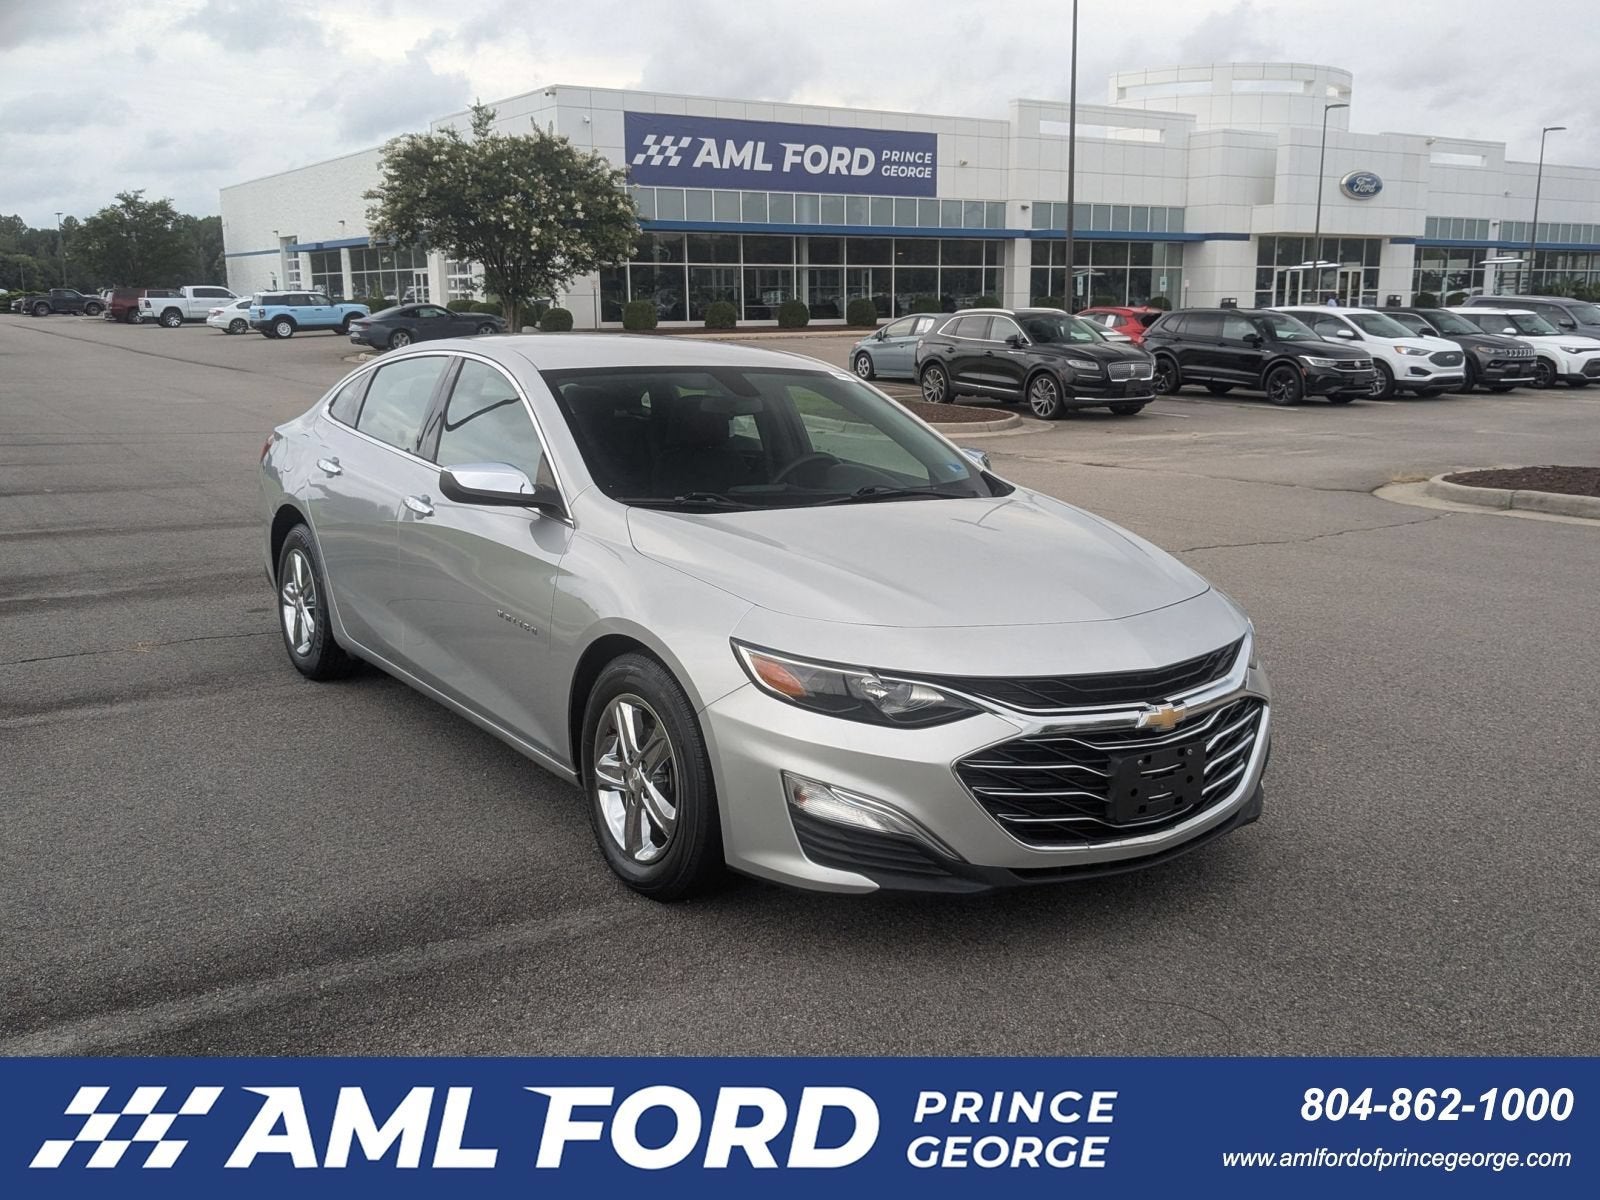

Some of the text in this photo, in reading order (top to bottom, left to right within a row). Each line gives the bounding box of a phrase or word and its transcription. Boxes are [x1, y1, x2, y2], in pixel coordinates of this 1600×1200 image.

[692, 137, 875, 176] AML FORD
[881, 150, 933, 164] PRINCE
[881, 165, 932, 178] GEORGE
